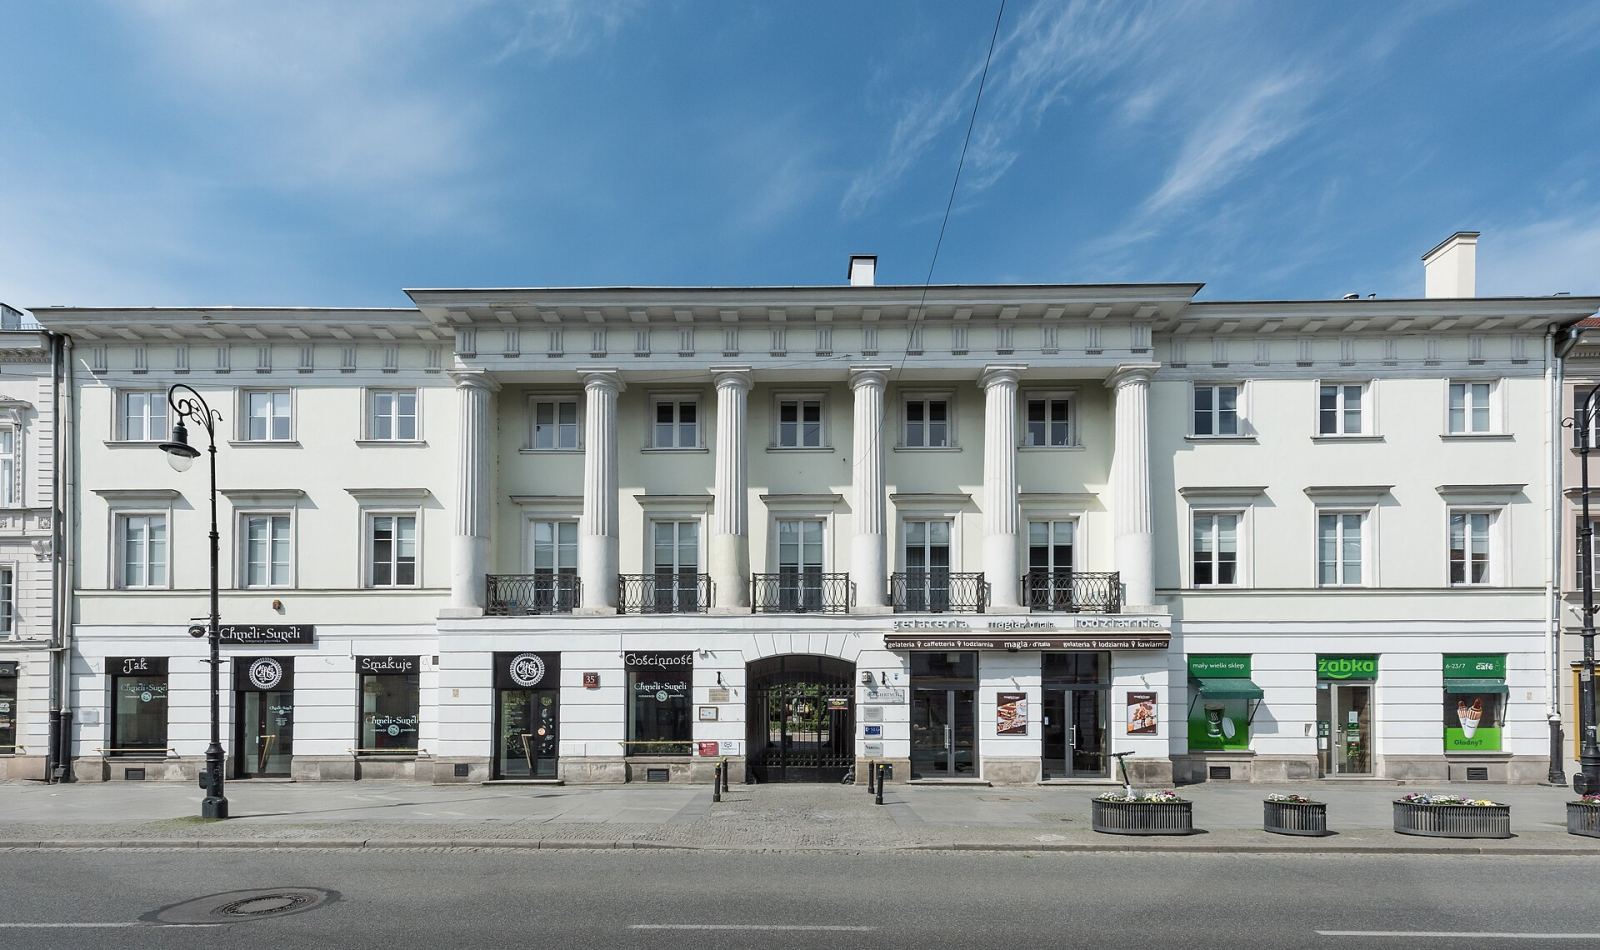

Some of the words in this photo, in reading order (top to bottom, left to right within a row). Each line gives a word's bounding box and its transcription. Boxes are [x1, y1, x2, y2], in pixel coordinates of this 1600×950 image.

[220, 626, 301, 643] Chmeli-Suneli
[887, 641, 915, 649] gelateria
[1004, 640, 1028, 649] magia
[1098, 640, 1129, 648] lodziarnia
[123, 657, 148, 674] Tak
[361, 656, 412, 673] Smakuje
[625, 653, 693, 670] Gościnność
[1192, 662, 1208, 670] mały
[1228, 662, 1244, 670] sklep
[1318, 658, 1374, 672] żabka
[1475, 662, 1494, 670] café
[585, 675, 595, 684] 35
